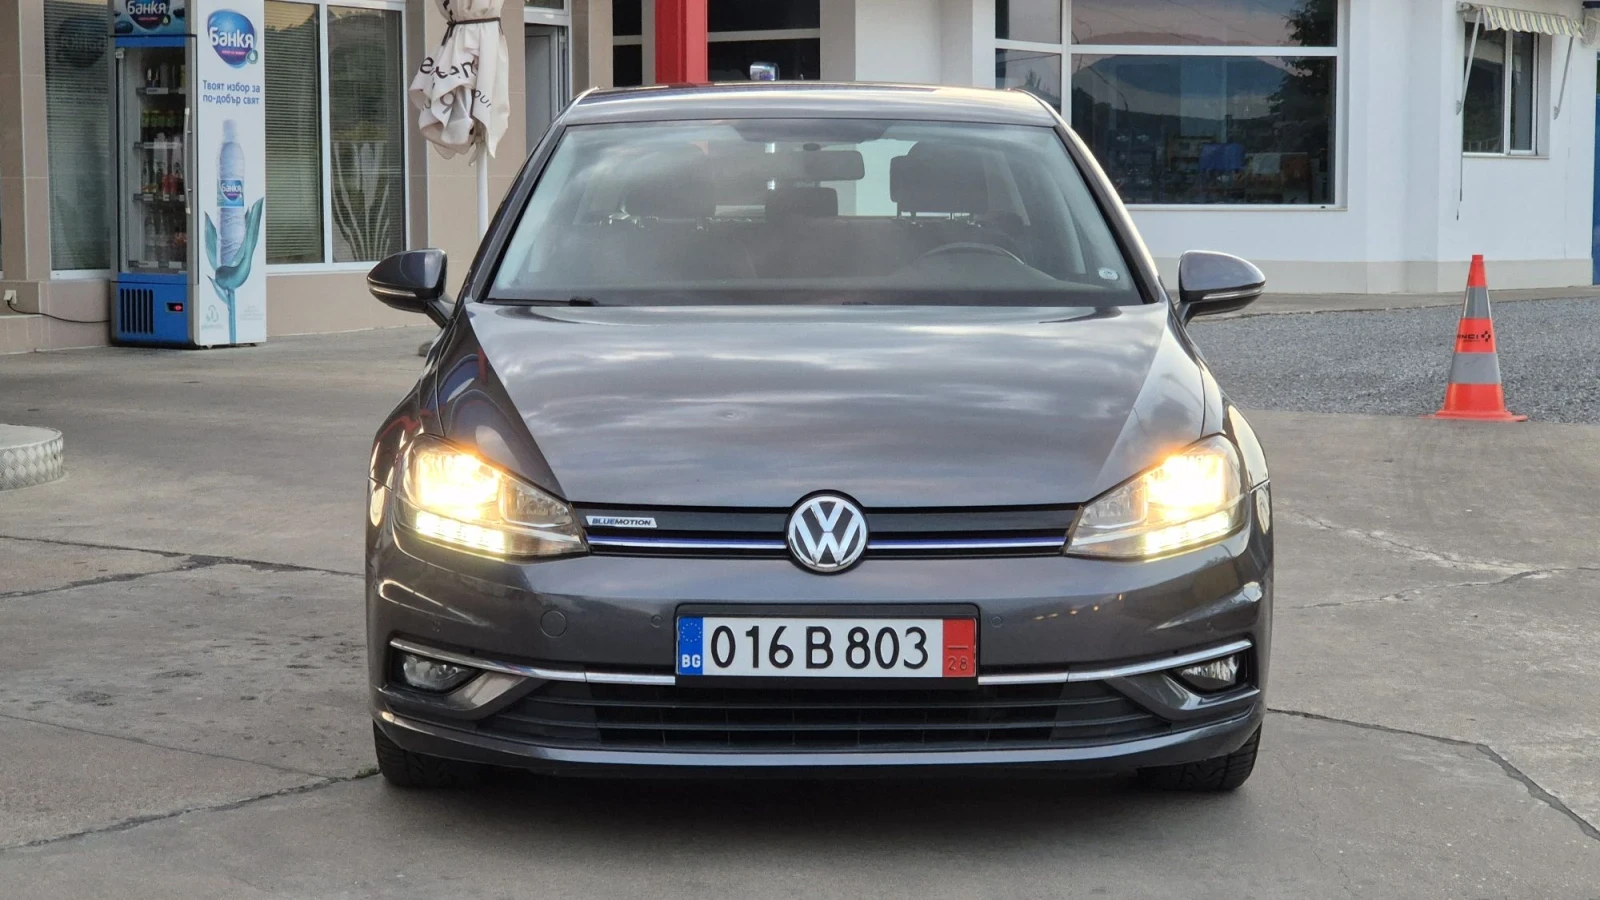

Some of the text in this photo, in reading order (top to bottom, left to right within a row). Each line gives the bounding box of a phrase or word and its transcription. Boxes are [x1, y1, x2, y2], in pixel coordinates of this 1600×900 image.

[203, 80, 261, 95] Твоят избор за
[203, 94, 260, 107] по-добър свят
[591, 517, 651, 526] BLUEMOTION
[681, 654, 701, 668] BG
[948, 656, 968, 671] 28
